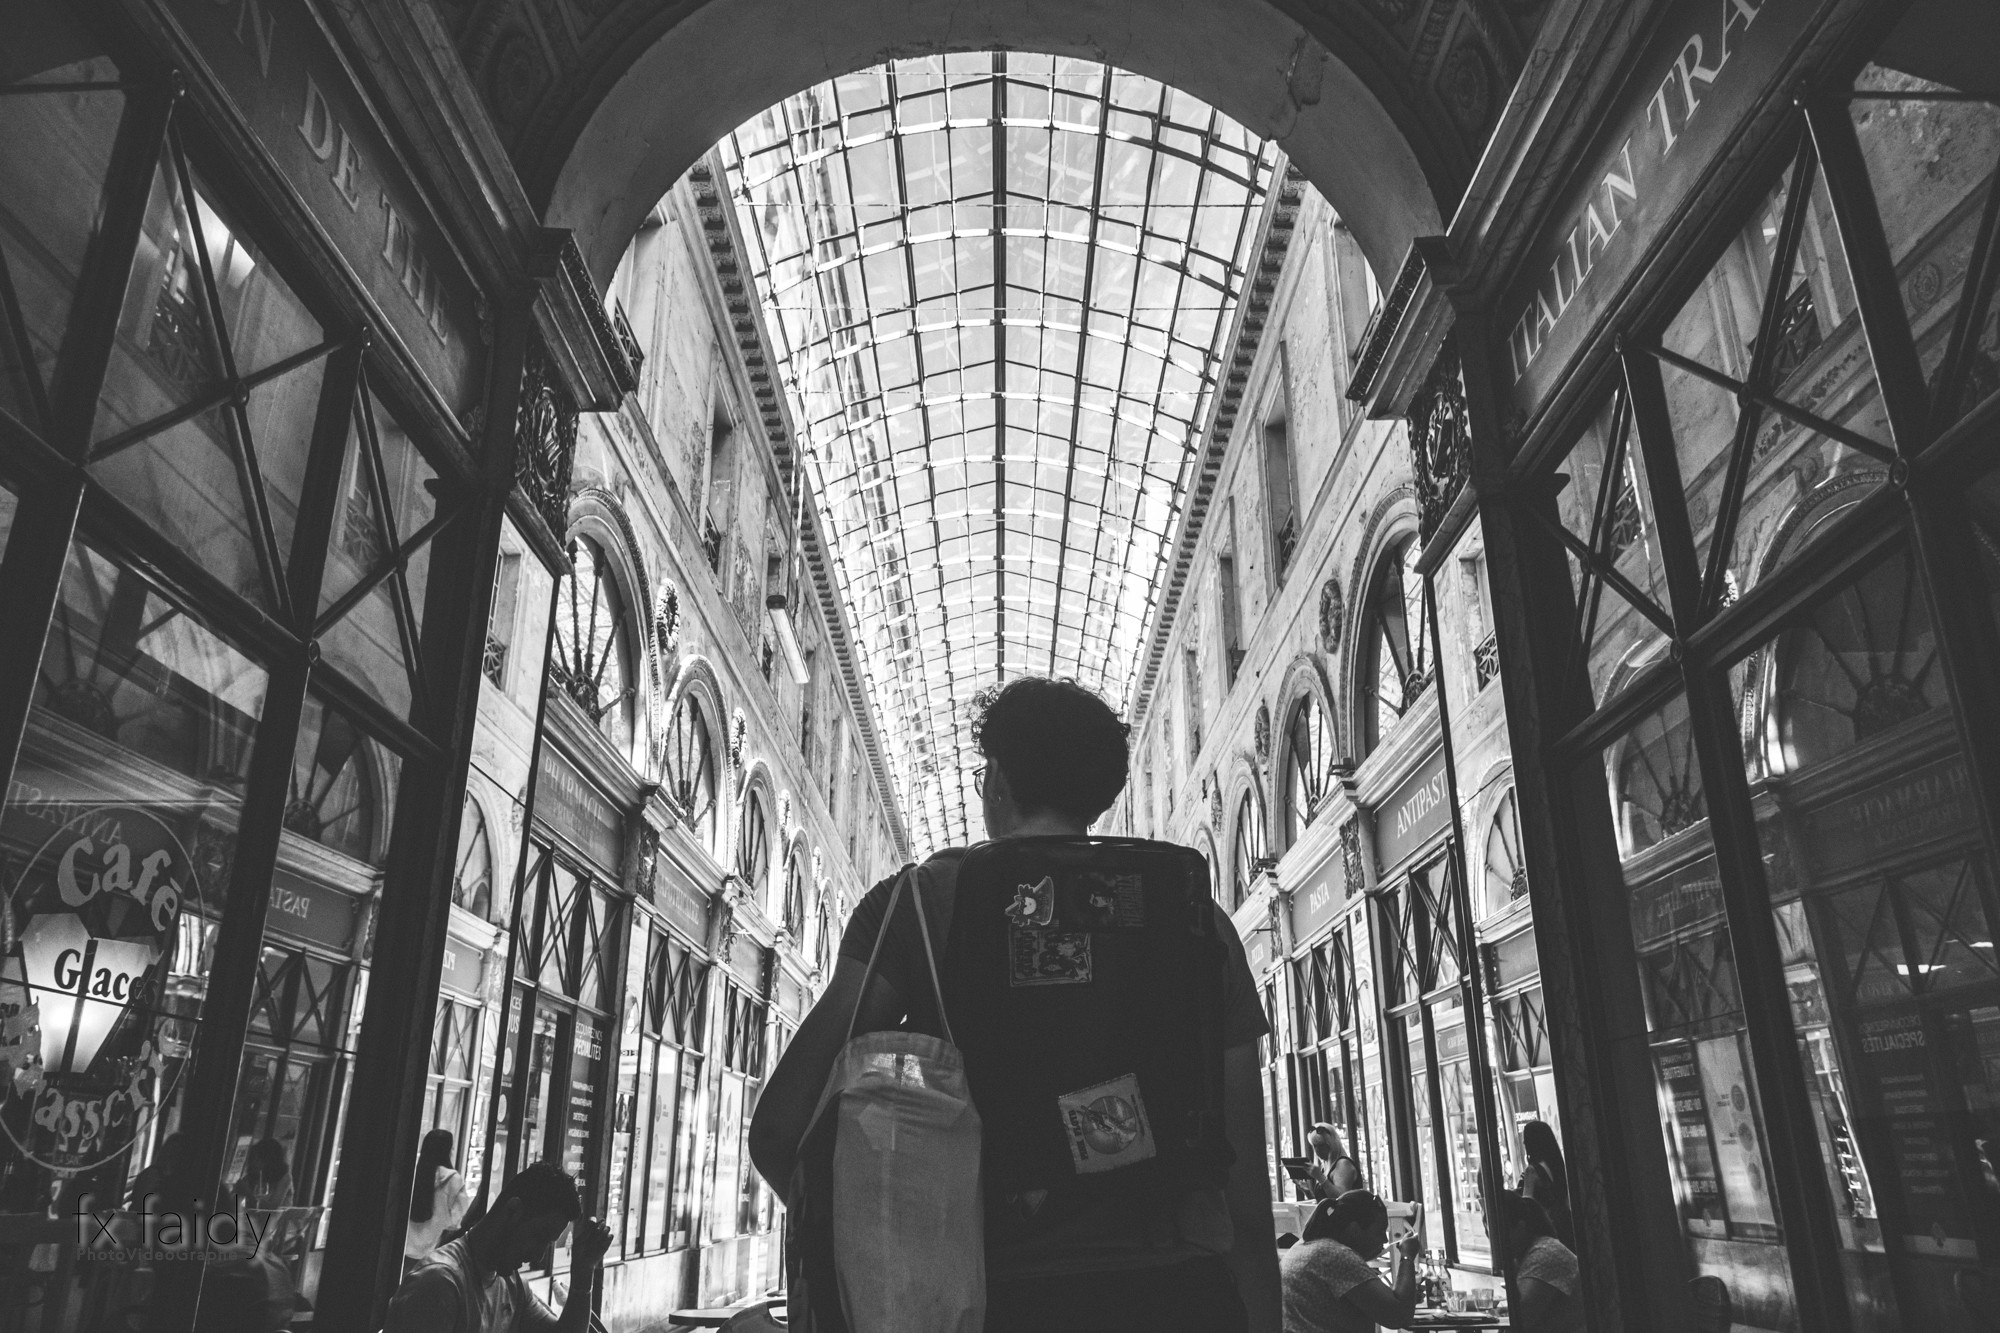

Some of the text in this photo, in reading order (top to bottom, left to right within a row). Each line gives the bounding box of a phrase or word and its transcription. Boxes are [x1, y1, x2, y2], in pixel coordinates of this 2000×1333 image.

[297, 72, 366, 212] DE
[1507, 0, 1769, 386] ITALIAN TRA
[57, 835, 183, 932] Café
[1309, 880, 1331, 915] PASTA
[53, 948, 158, 1006] Glaces
[573, 1035, 602, 1061] PÉCIALITÉS
[1068, 1109, 1082, 1137] FLOYD
